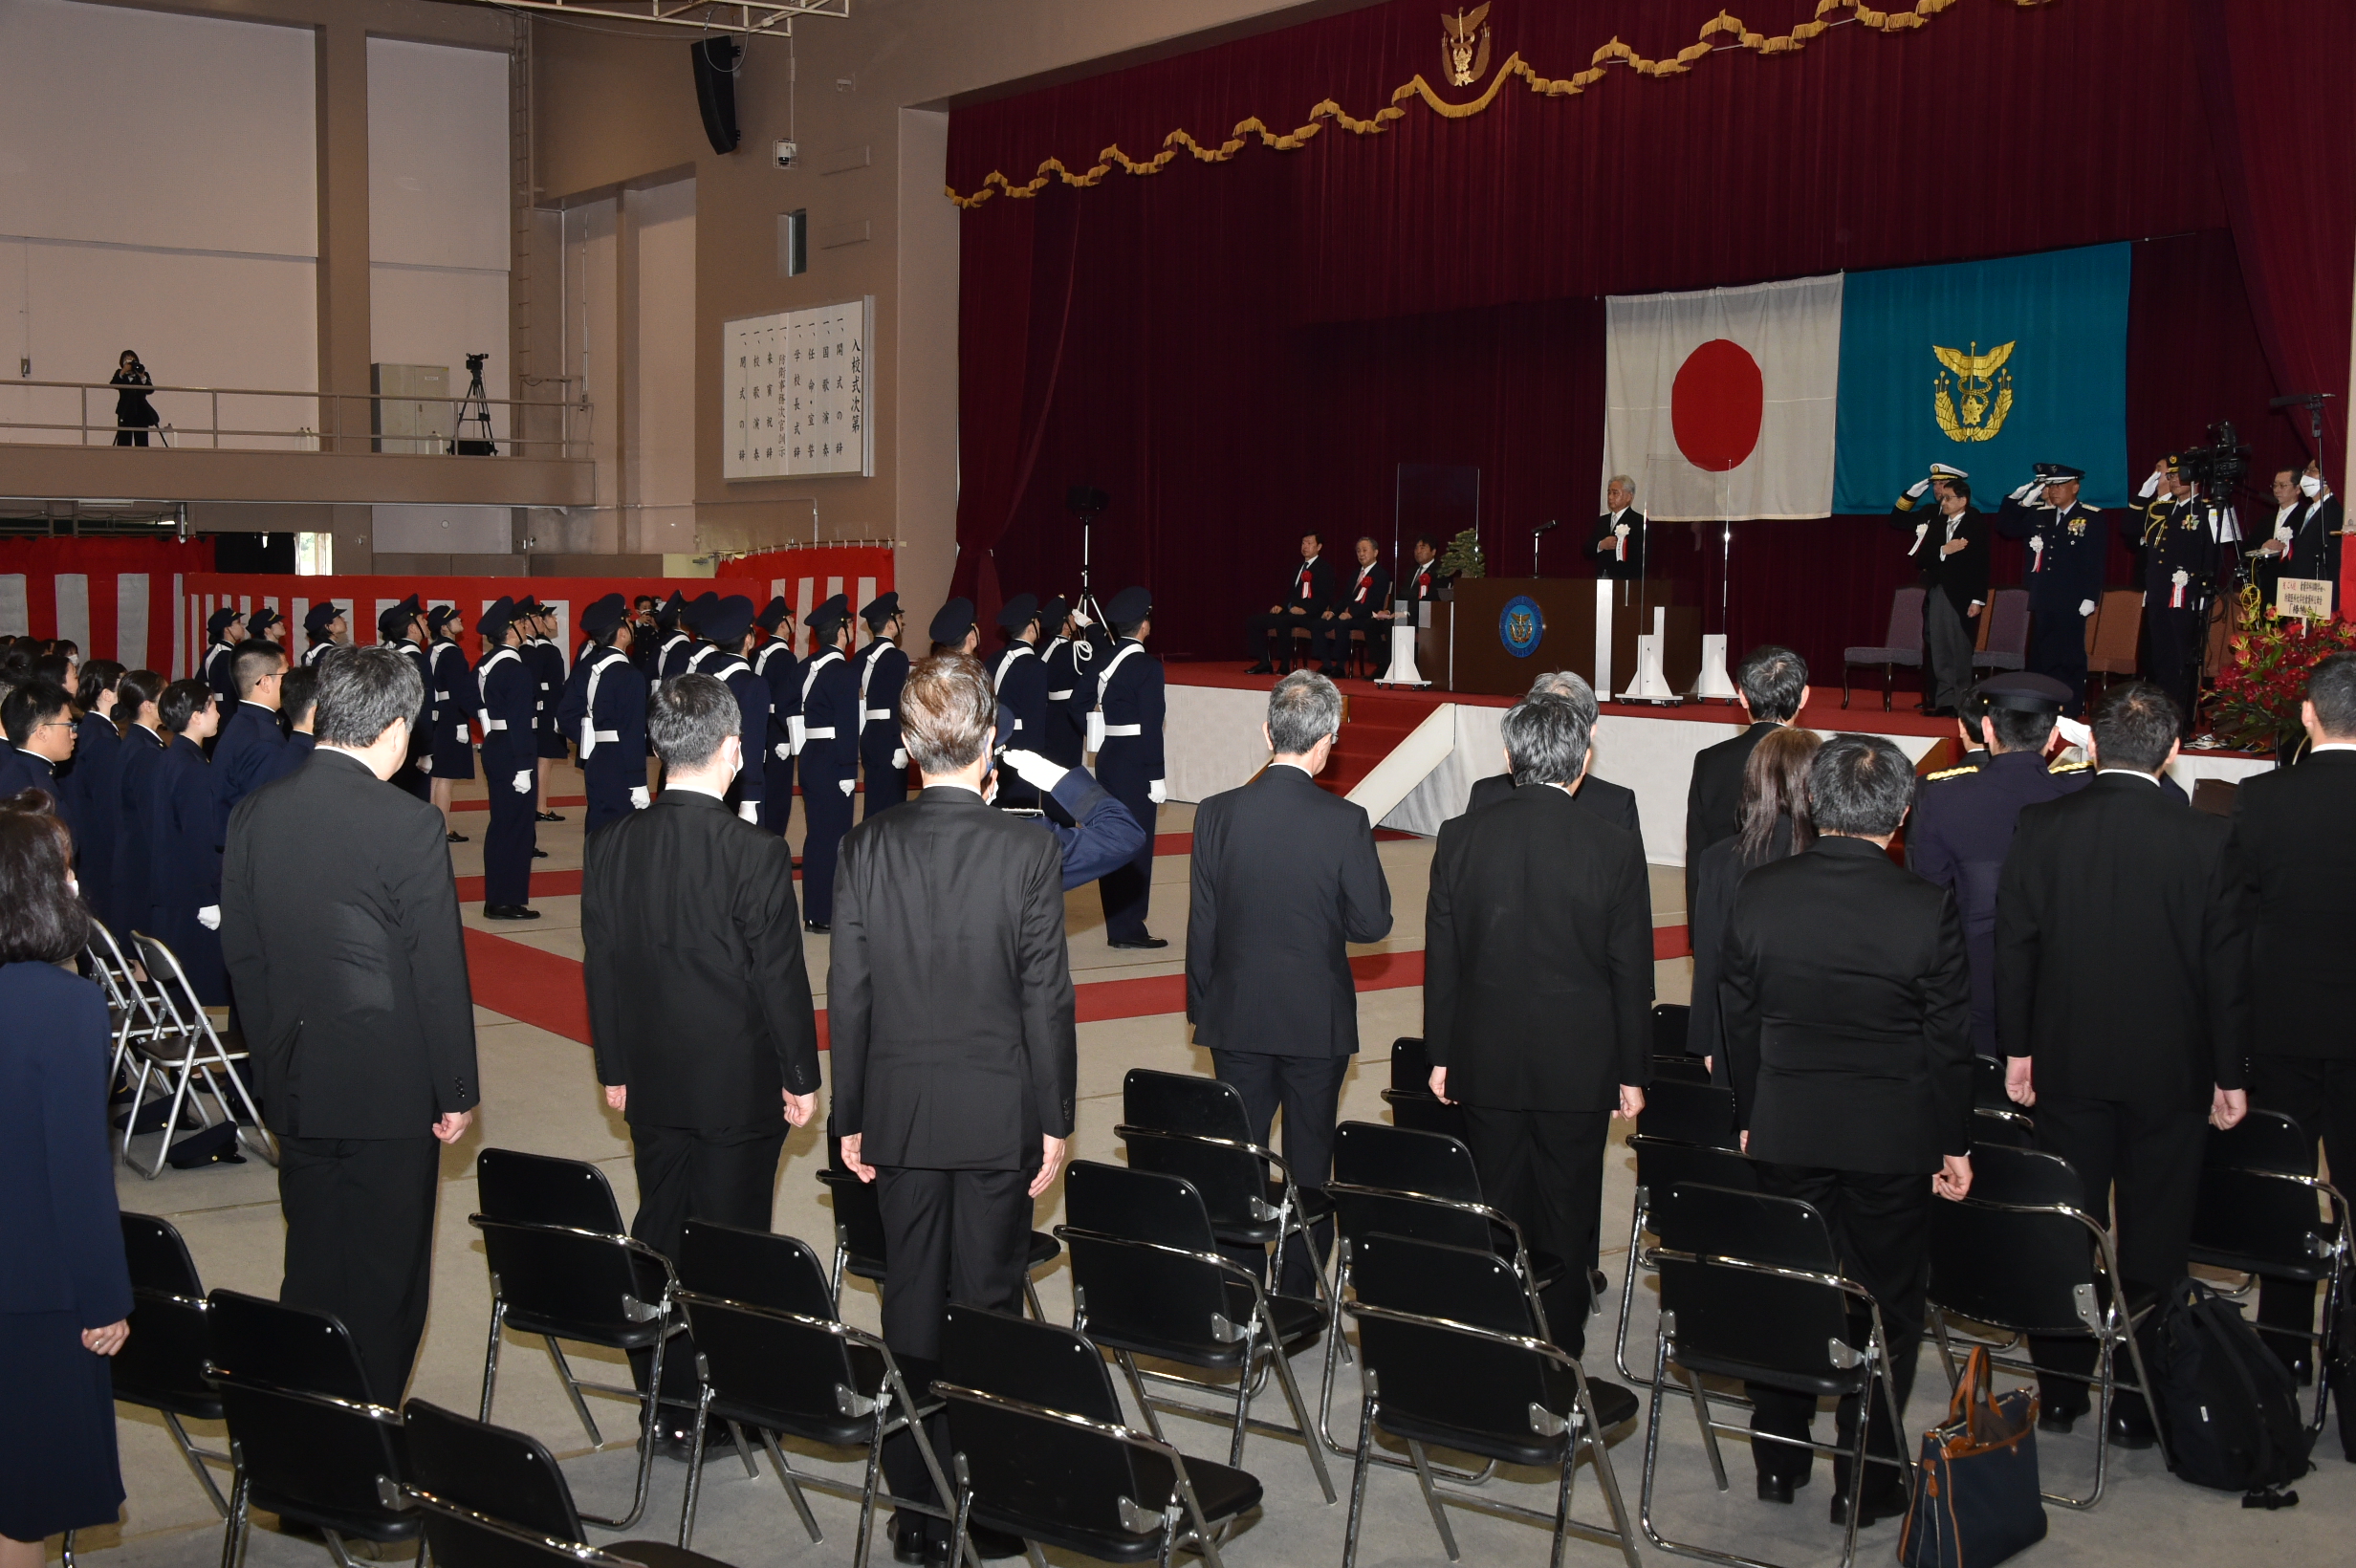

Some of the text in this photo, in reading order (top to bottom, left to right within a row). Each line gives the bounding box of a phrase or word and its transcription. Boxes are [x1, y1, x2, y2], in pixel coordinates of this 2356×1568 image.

[851, 338, 862, 433] 入校式次第
